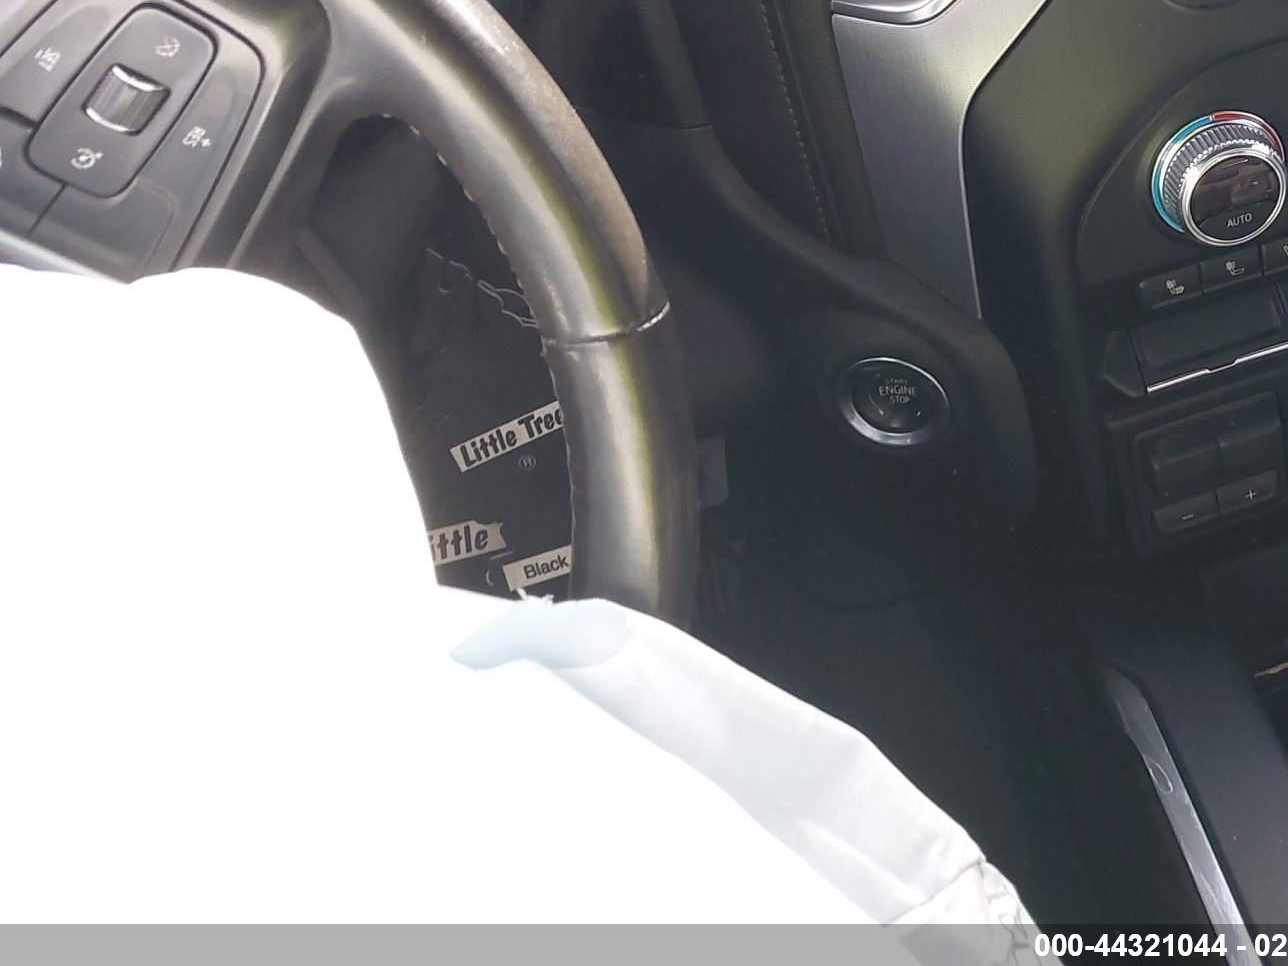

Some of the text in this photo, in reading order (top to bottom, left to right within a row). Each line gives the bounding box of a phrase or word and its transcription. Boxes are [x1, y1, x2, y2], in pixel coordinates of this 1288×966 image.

[1226, 212, 1253, 229] AUTO
[878, 385, 916, 396] ENGINE
[889, 395, 911, 403] STOP
[460, 428, 518, 468] Little
[523, 554, 570, 580] Black
